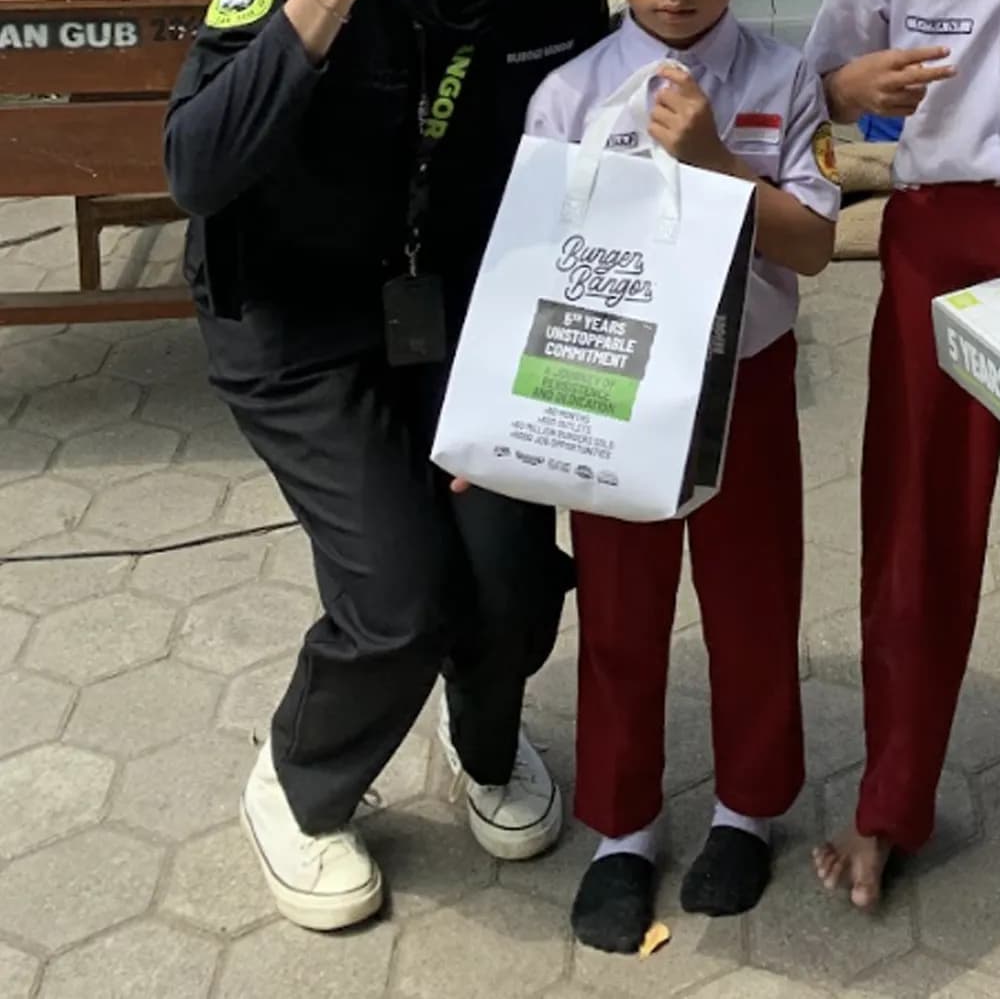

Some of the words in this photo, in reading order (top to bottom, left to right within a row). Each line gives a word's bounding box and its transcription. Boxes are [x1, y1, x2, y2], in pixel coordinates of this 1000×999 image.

[0, 23, 48, 49] AN
[59, 21, 138, 48] GUB
[556, 234, 644, 276] Burger
[564, 265, 654, 308] Bangor
[546, 325, 638, 354] UNSTOPPABLE
[584, 314, 628, 336] YEARS
[544, 342, 630, 369] COMMITMENT
[946, 326, 960, 362] 5
